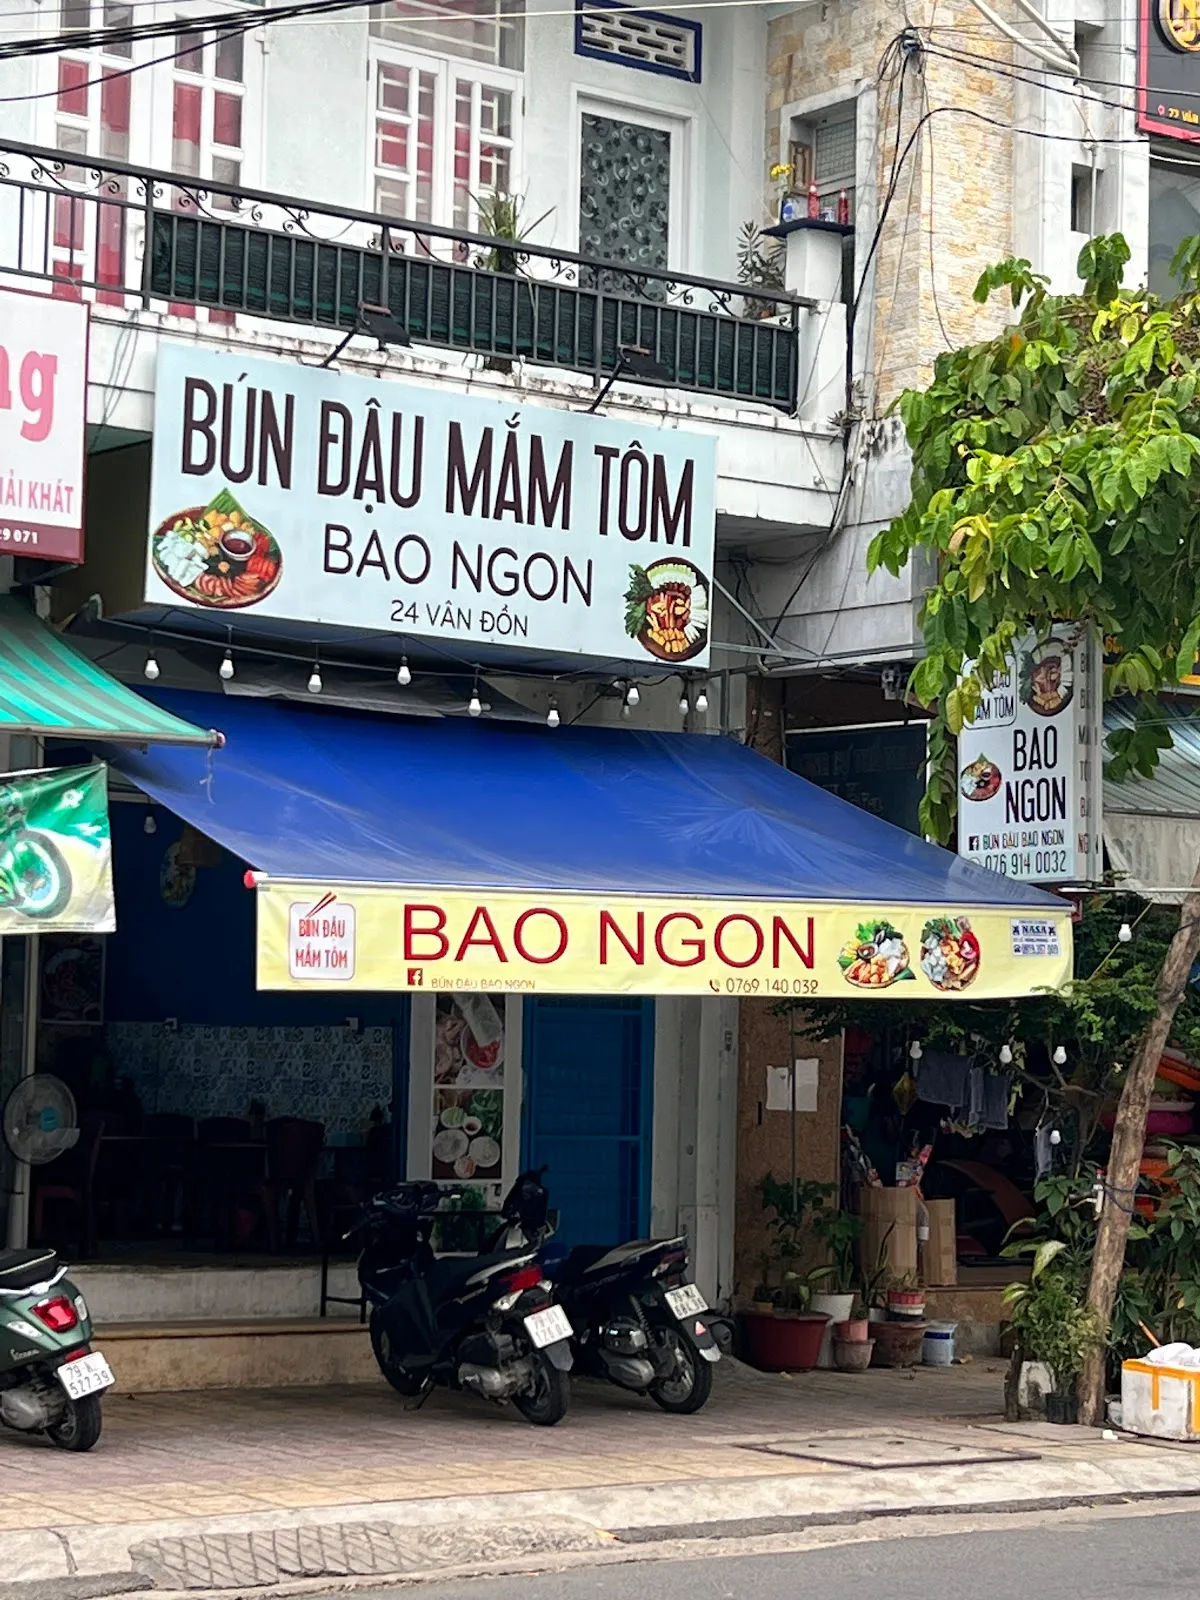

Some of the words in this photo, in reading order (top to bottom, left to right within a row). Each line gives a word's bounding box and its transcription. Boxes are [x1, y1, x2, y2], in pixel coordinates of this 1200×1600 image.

[182, 372, 295, 490] BÚN
[316, 398, 425, 514] ĐẬU
[446, 412, 573, 531] MẮM
[594, 440, 695, 547] TÔM
[28, 478, 75, 514] KHÁT
[323, 524, 431, 586] BAO
[451, 542, 594, 606] NGON
[390, 599, 420, 624] 24
[425, 600, 472, 631] VÂN
[1013, 725, 1058, 772] BAO
[1005, 776, 1066, 823] NGON
[1011, 852, 1031, 875] 914
[1035, 850, 1067, 873] 0032
[403, 904, 569, 964] BAO
[599, 911, 816, 970] NGON
[480, 978, 503, 990] BAO
